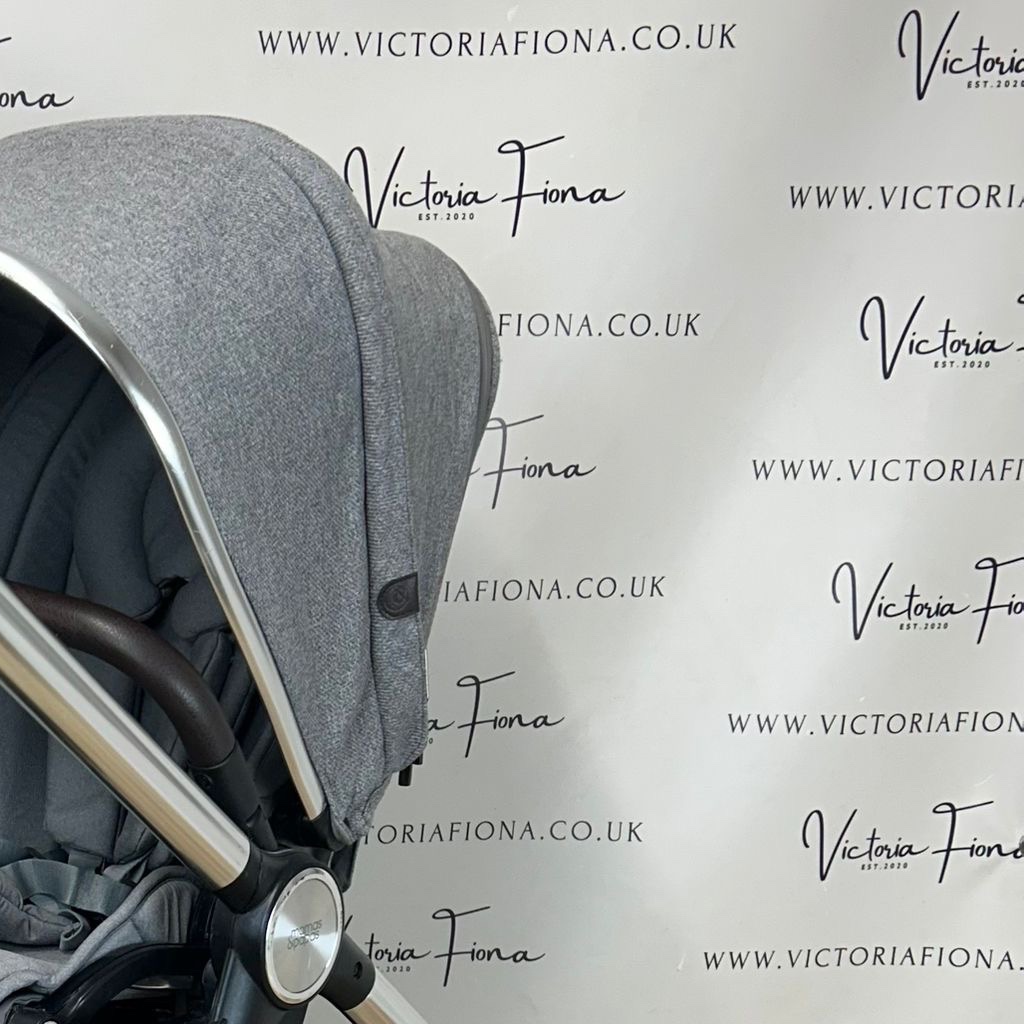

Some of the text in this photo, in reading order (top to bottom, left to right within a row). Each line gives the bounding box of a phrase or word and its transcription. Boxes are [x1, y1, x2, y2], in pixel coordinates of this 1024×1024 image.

[258, 24, 736, 57] WWW.VICTORIAFIONA.CO.UK
[344, 135, 626, 237] Victoria Fiona
[418, 212, 474, 221] EST.2020
[860, 295, 1014, 380] Victoria
[933, 360, 991, 369] EST.2020
[483, 414, 597, 510] Fiona
[832, 562, 970, 640] Victoria
[456, 671, 565, 758] Fiona
[802, 809, 929, 881] Victoria
[432, 906, 545, 987] Fiona
